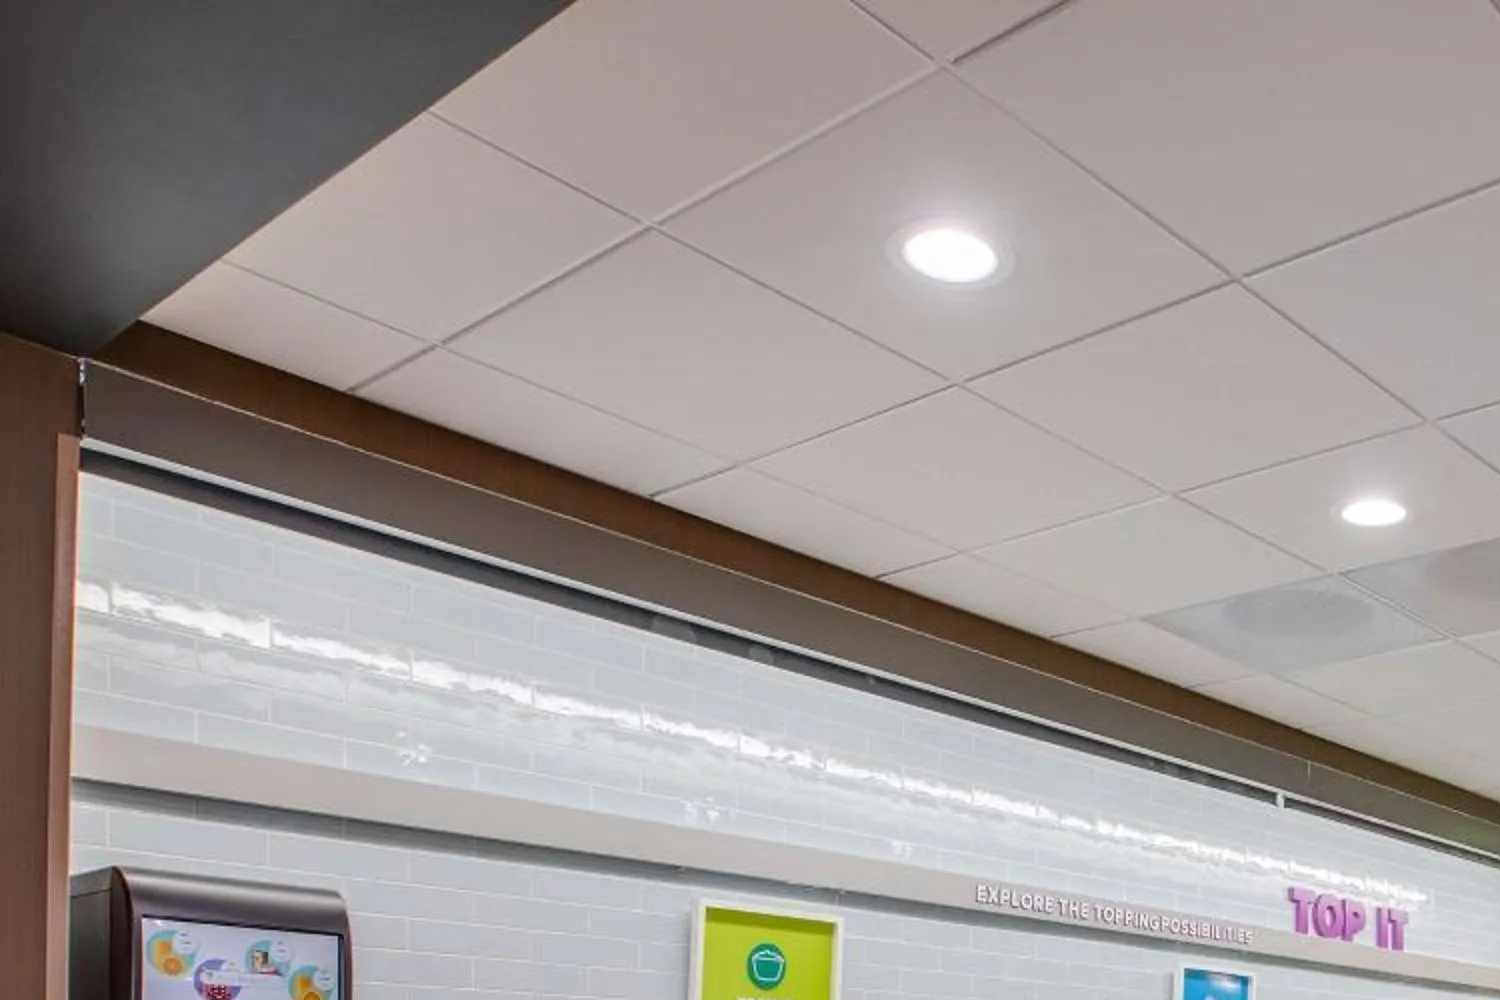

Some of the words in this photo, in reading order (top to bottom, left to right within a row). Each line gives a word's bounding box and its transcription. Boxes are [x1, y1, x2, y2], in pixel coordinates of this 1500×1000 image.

[976, 884, 1055, 913] EXPLORE
[1058, 898, 1089, 920] THE
[1287, 886, 1367, 943] TOP
[1375, 906, 1409, 951] IT
